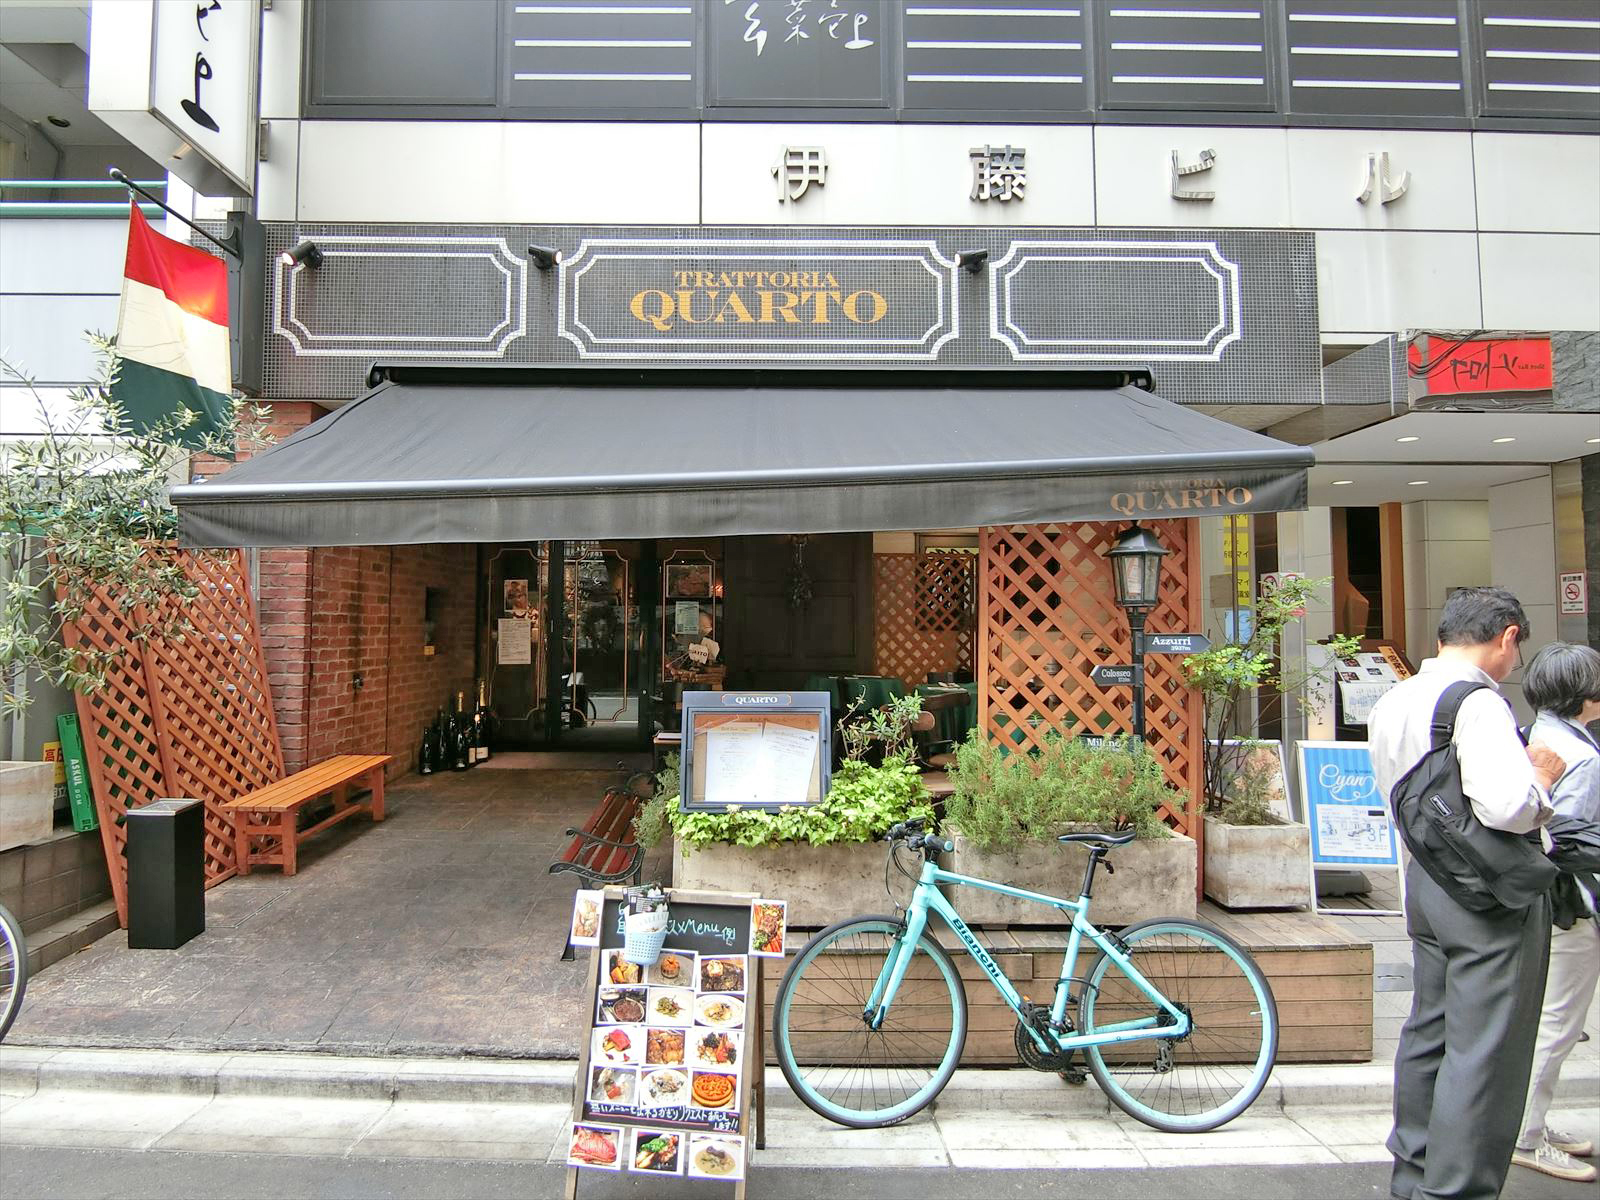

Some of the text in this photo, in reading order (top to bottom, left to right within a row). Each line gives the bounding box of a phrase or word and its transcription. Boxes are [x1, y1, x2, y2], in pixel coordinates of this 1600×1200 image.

[770, 144, 1410, 204] 伊藤ビル
[674, 271, 839, 288] TRATTORIA
[630, 289, 888, 331] QUARTO
[1136, 478, 1225, 490] TRATTORIA
[1110, 487, 1253, 516] QUARTO
[1152, 636, 1191, 646] Azzurri
[1101, 668, 1131, 678] Colosseo
[70, 758, 83, 786] ASKUL
[1319, 763, 1376, 802] Cyan
[953, 918, 1000, 978] Bianchi
